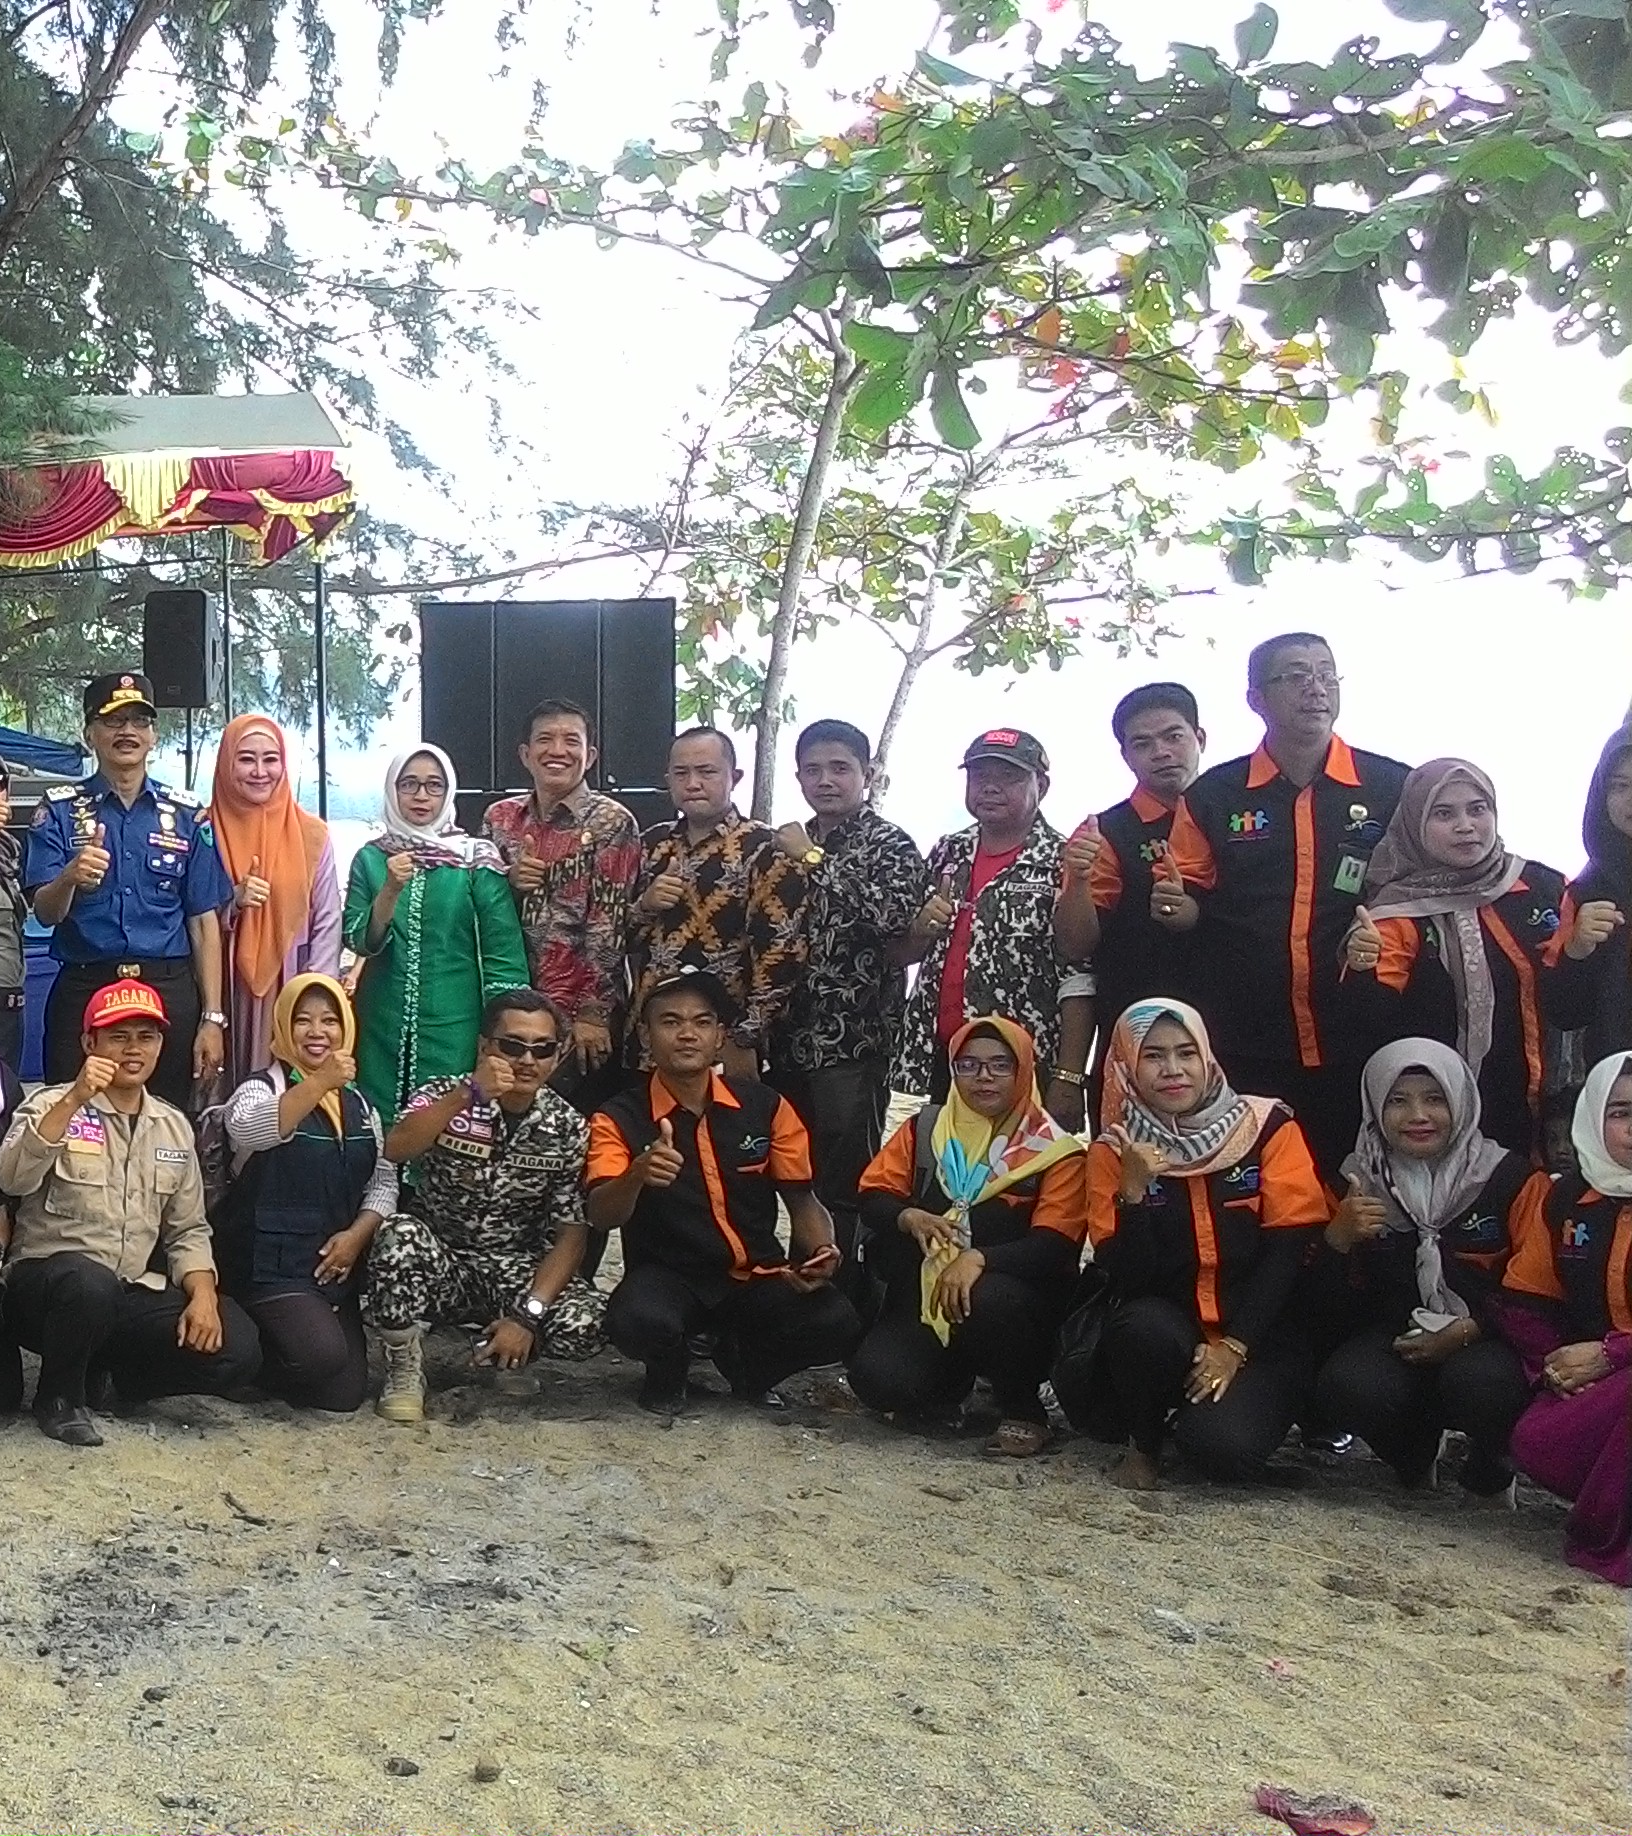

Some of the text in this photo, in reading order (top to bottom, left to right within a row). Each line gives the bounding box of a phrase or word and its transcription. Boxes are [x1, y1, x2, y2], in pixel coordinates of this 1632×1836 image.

[1012, 884, 1051, 894] TAGANA
[104, 988, 156, 1008] TAGANA
[511, 1154, 562, 1169] TAGANA
